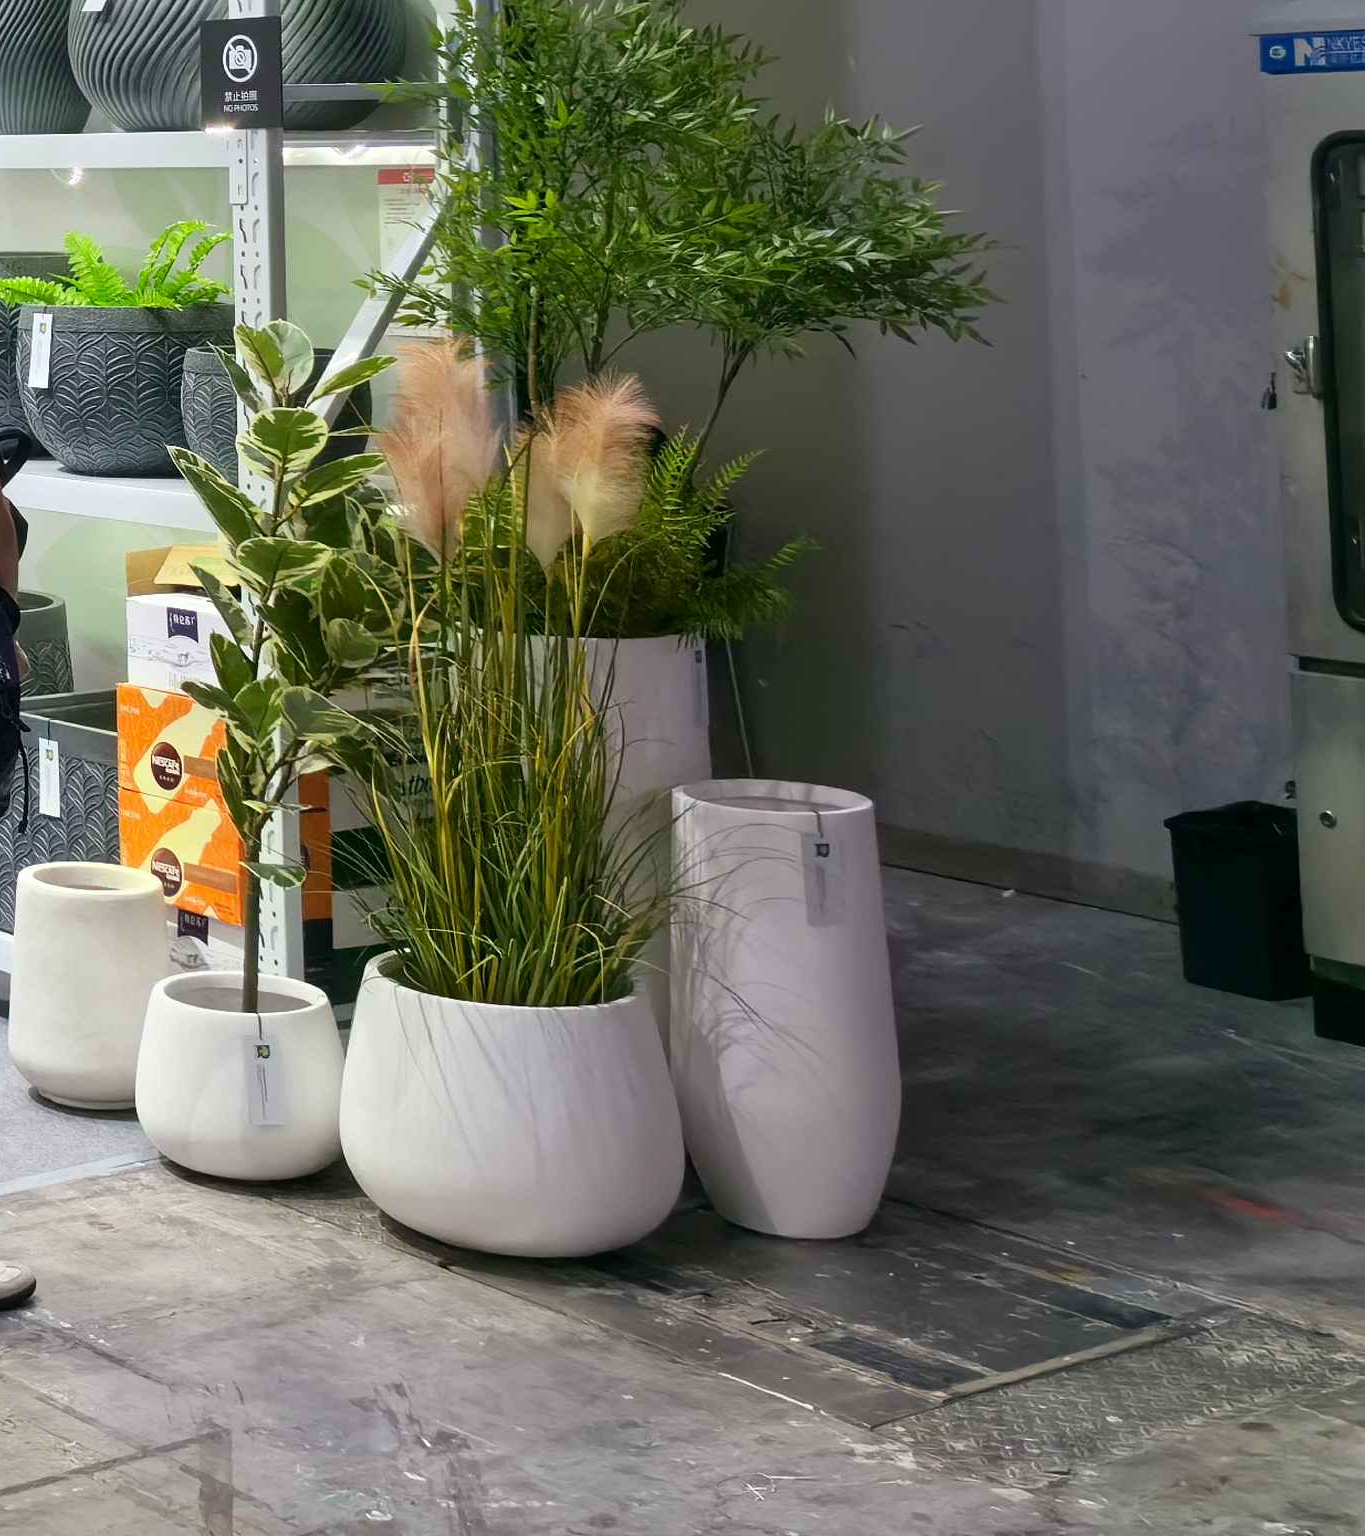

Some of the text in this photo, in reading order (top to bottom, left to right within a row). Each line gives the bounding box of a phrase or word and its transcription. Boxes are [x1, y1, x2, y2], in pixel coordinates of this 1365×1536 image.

[224, 90, 258, 102] 禁止拍照
[223, 104, 259, 113] NO PHOTOS
